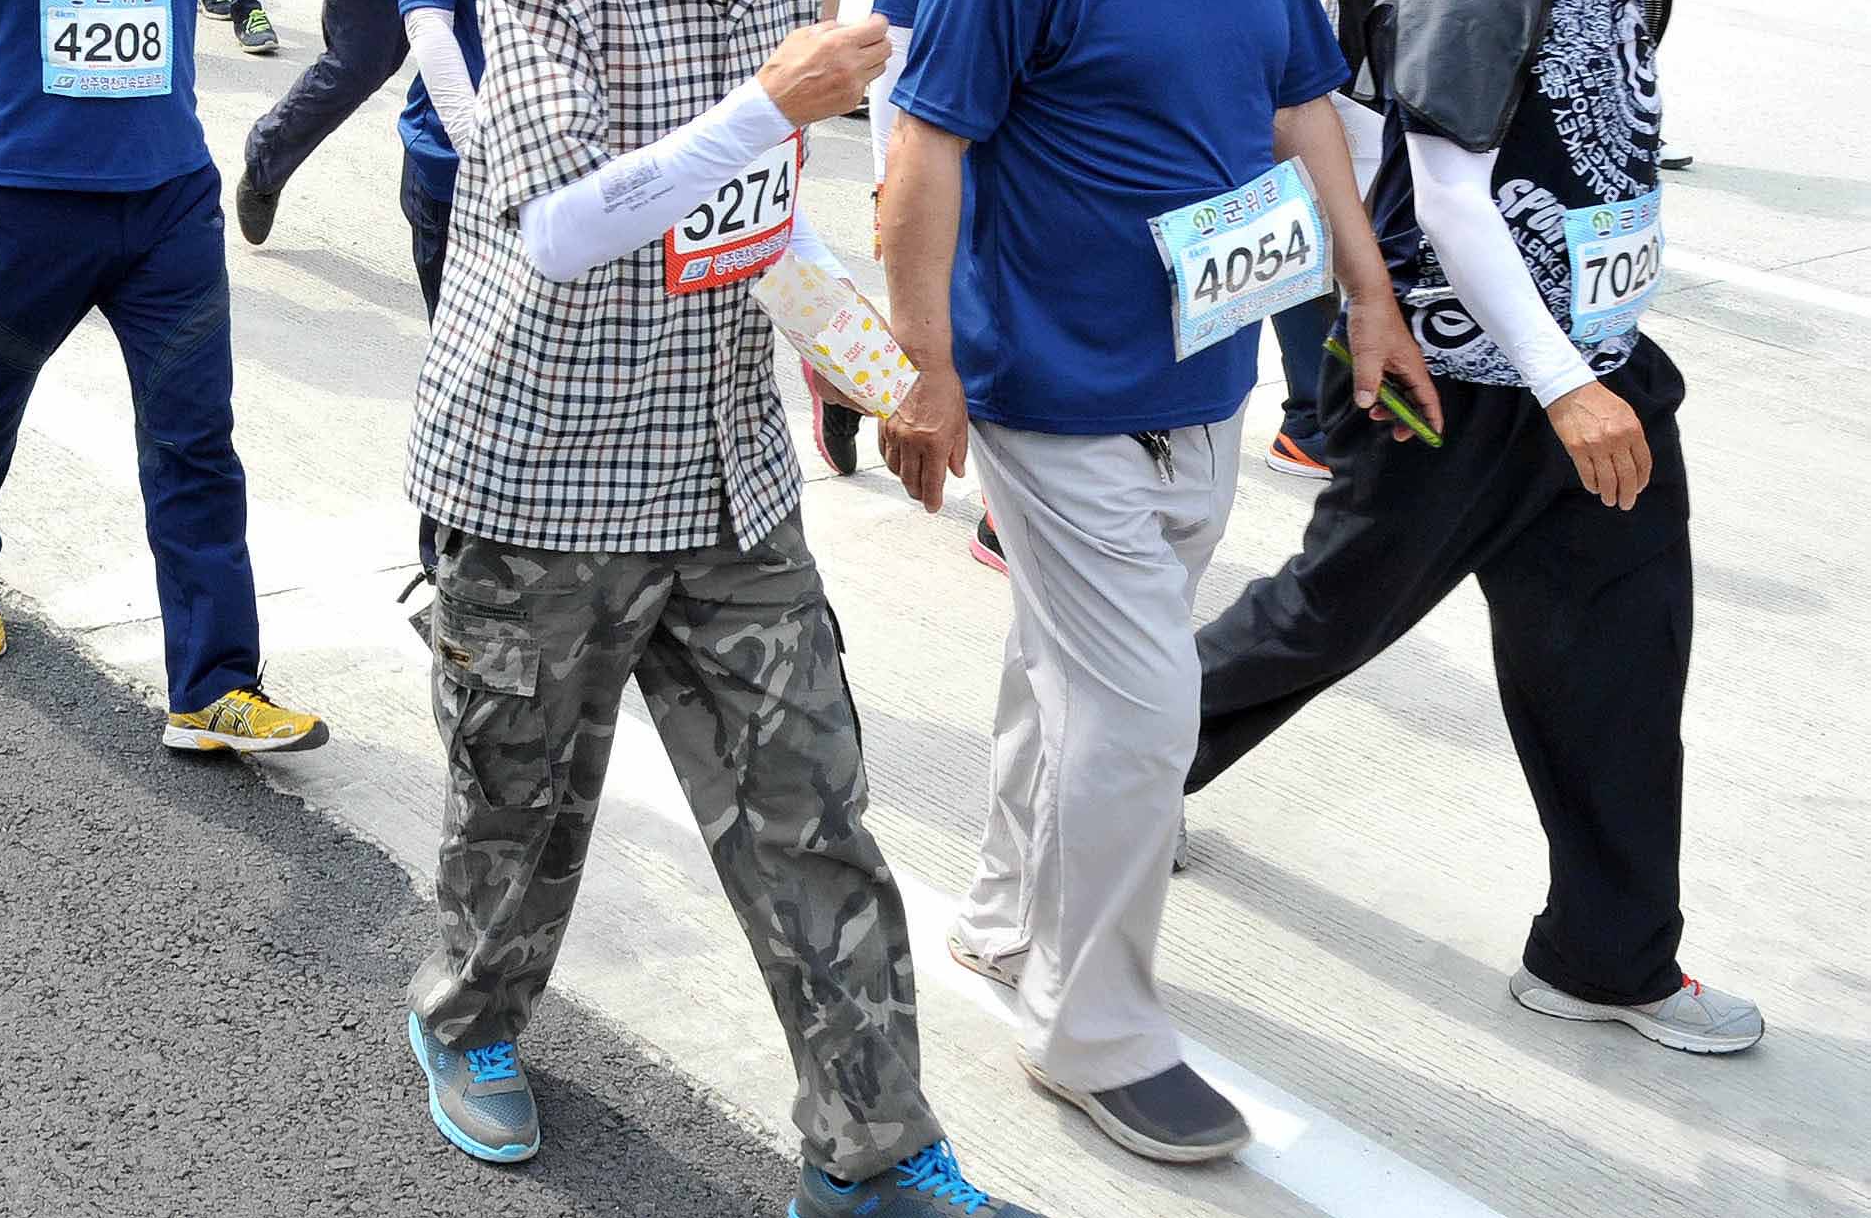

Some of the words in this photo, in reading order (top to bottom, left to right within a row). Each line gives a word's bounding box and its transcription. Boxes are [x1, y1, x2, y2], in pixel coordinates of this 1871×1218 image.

[53, 21, 162, 63] 4208
[683, 160, 791, 242] 5274
[1222, 179, 1279, 225] 군위군
[1193, 218, 1312, 304] 4054
